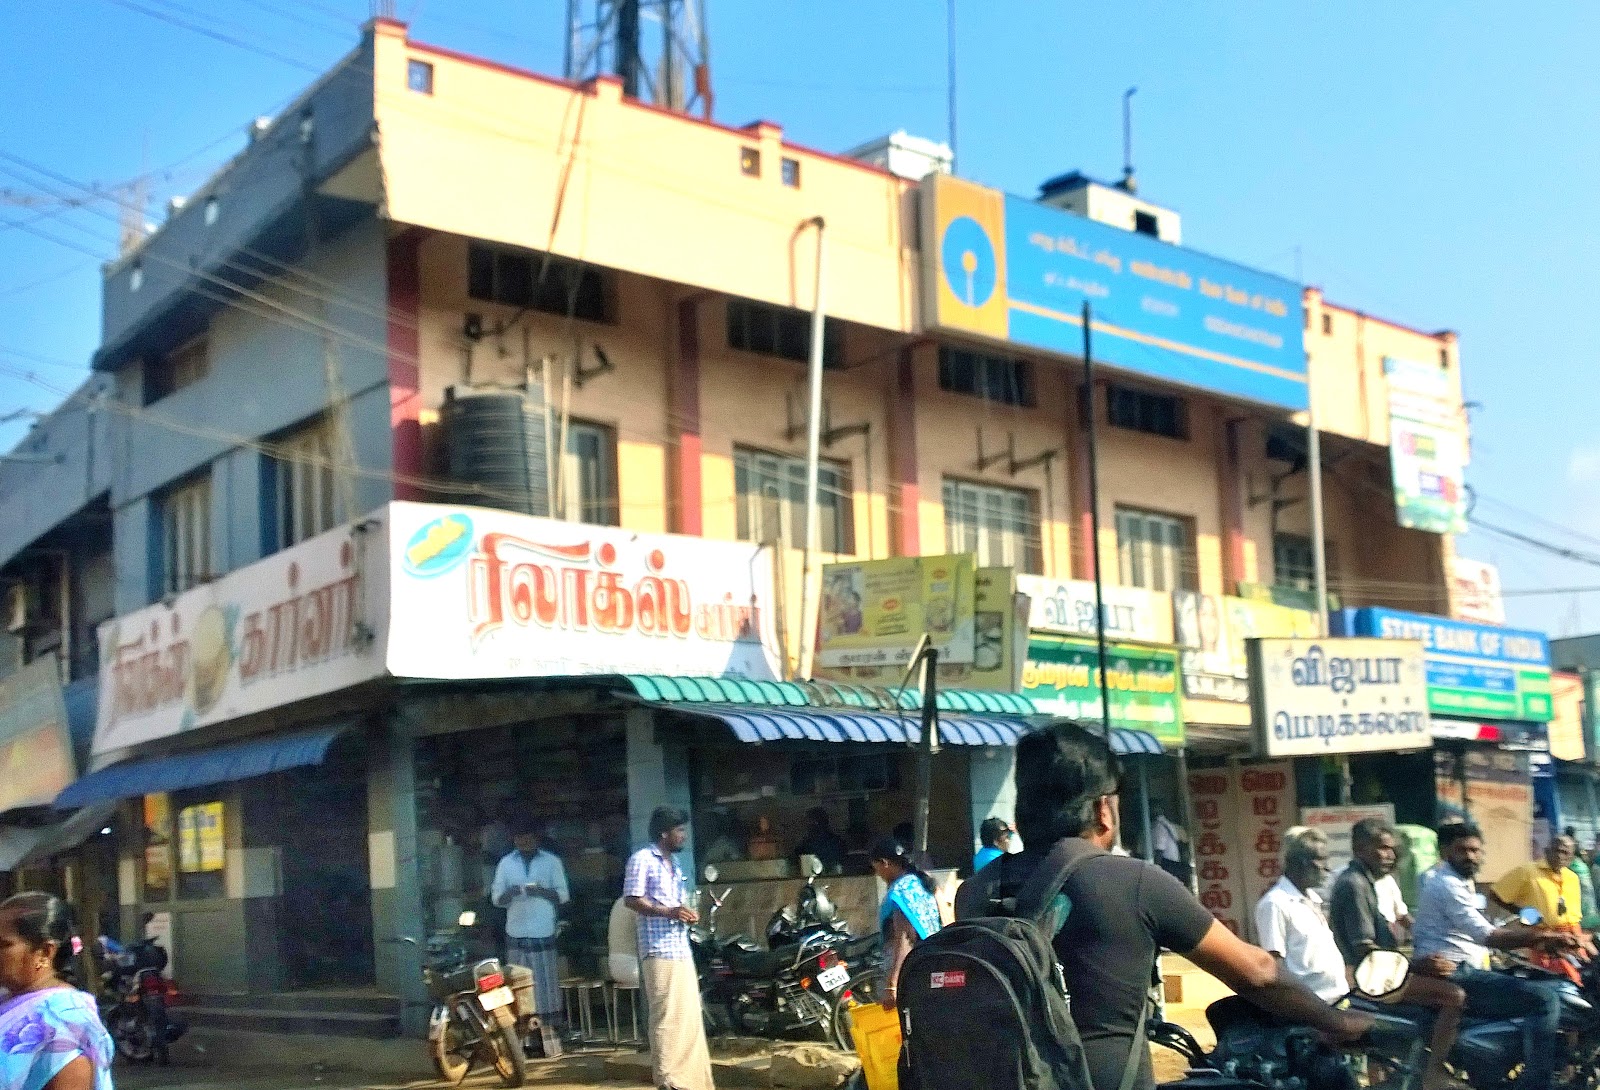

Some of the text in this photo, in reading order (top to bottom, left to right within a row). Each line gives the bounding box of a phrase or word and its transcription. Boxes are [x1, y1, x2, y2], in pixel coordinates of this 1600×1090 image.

[466, 531, 692, 652] ரிலாக்ஸ்
[1291, 645, 1403, 693] விஜயா
[1274, 696, 1425, 746] மெடிக்கல்ஸ்
